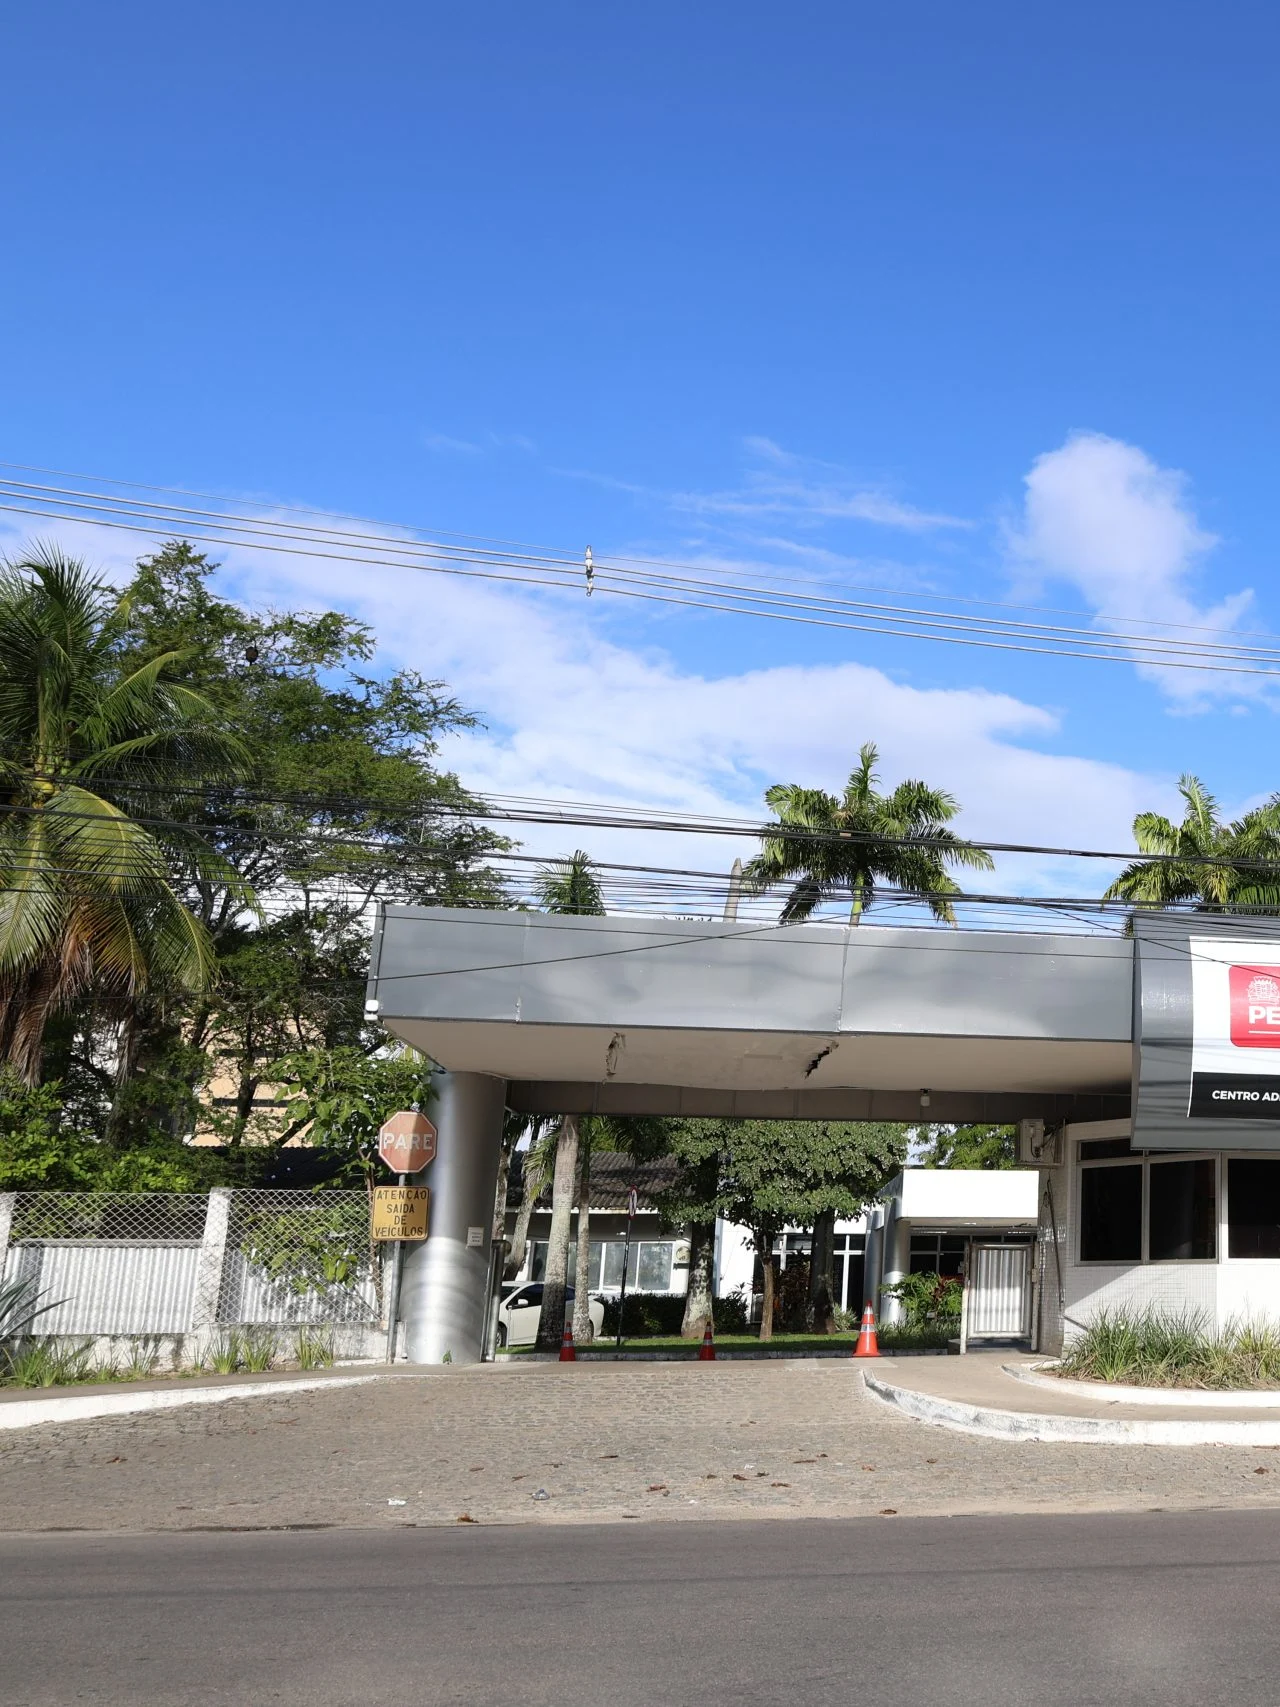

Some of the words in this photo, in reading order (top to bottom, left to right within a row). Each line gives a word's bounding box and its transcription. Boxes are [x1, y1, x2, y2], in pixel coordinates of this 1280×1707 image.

[1212, 1090, 1259, 1101] CENTRO
[383, 1132, 433, 1150] PARE
[393, 1214, 407, 1226] DE
[375, 1224, 424, 1237] VEÍCULOS
